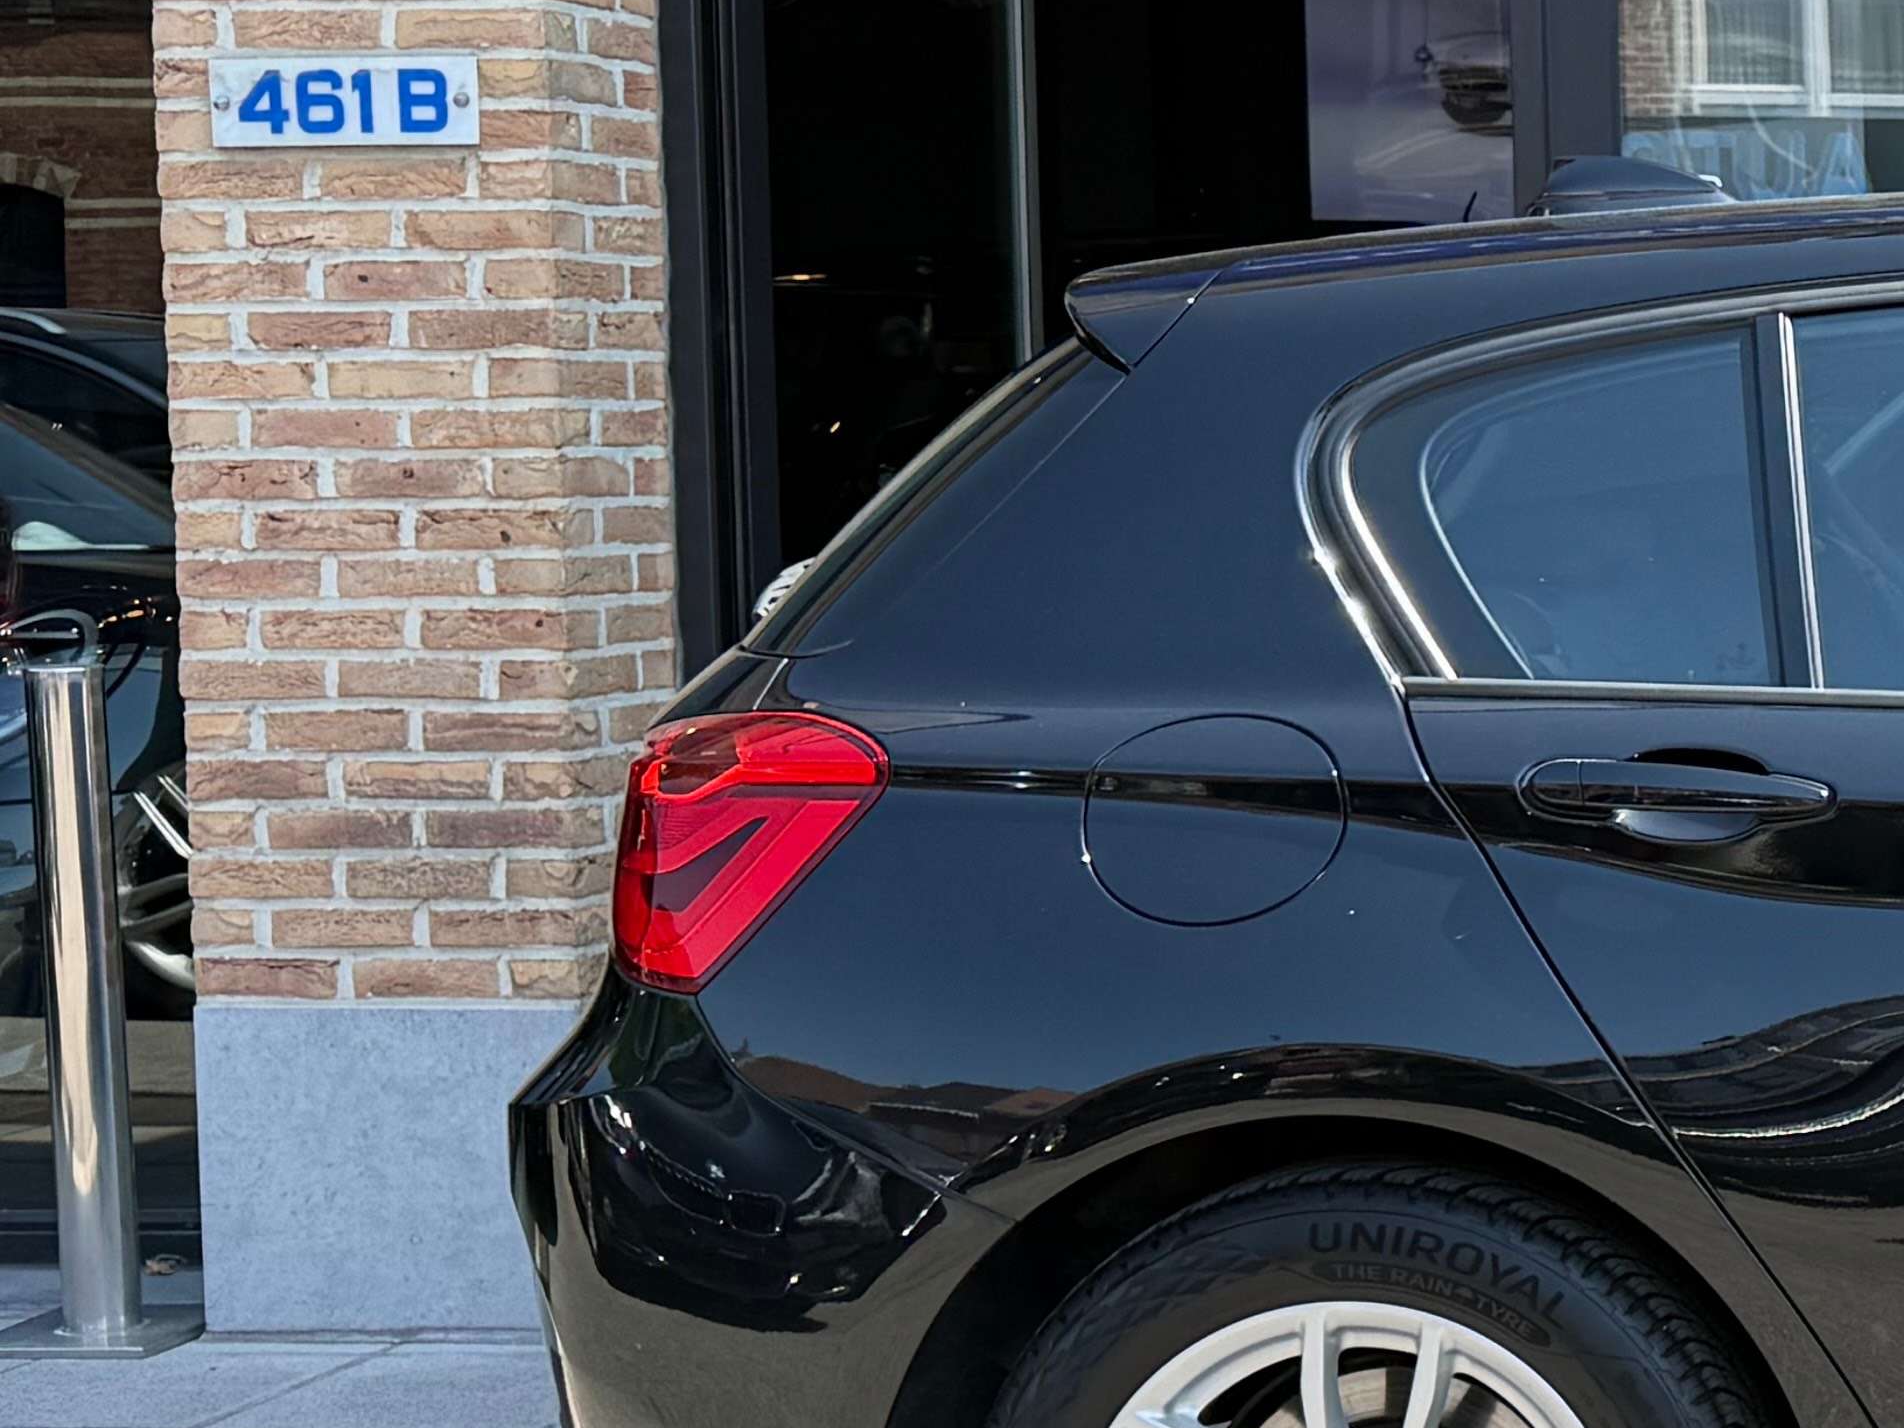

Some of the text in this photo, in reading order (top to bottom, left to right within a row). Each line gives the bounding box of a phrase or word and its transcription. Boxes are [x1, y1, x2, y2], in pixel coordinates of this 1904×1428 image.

[238, 68, 450, 136] 461 B
[1308, 1222, 1563, 1329] UNIROYAL
[1333, 1262, 1532, 1338] THE RAIN TYRE
